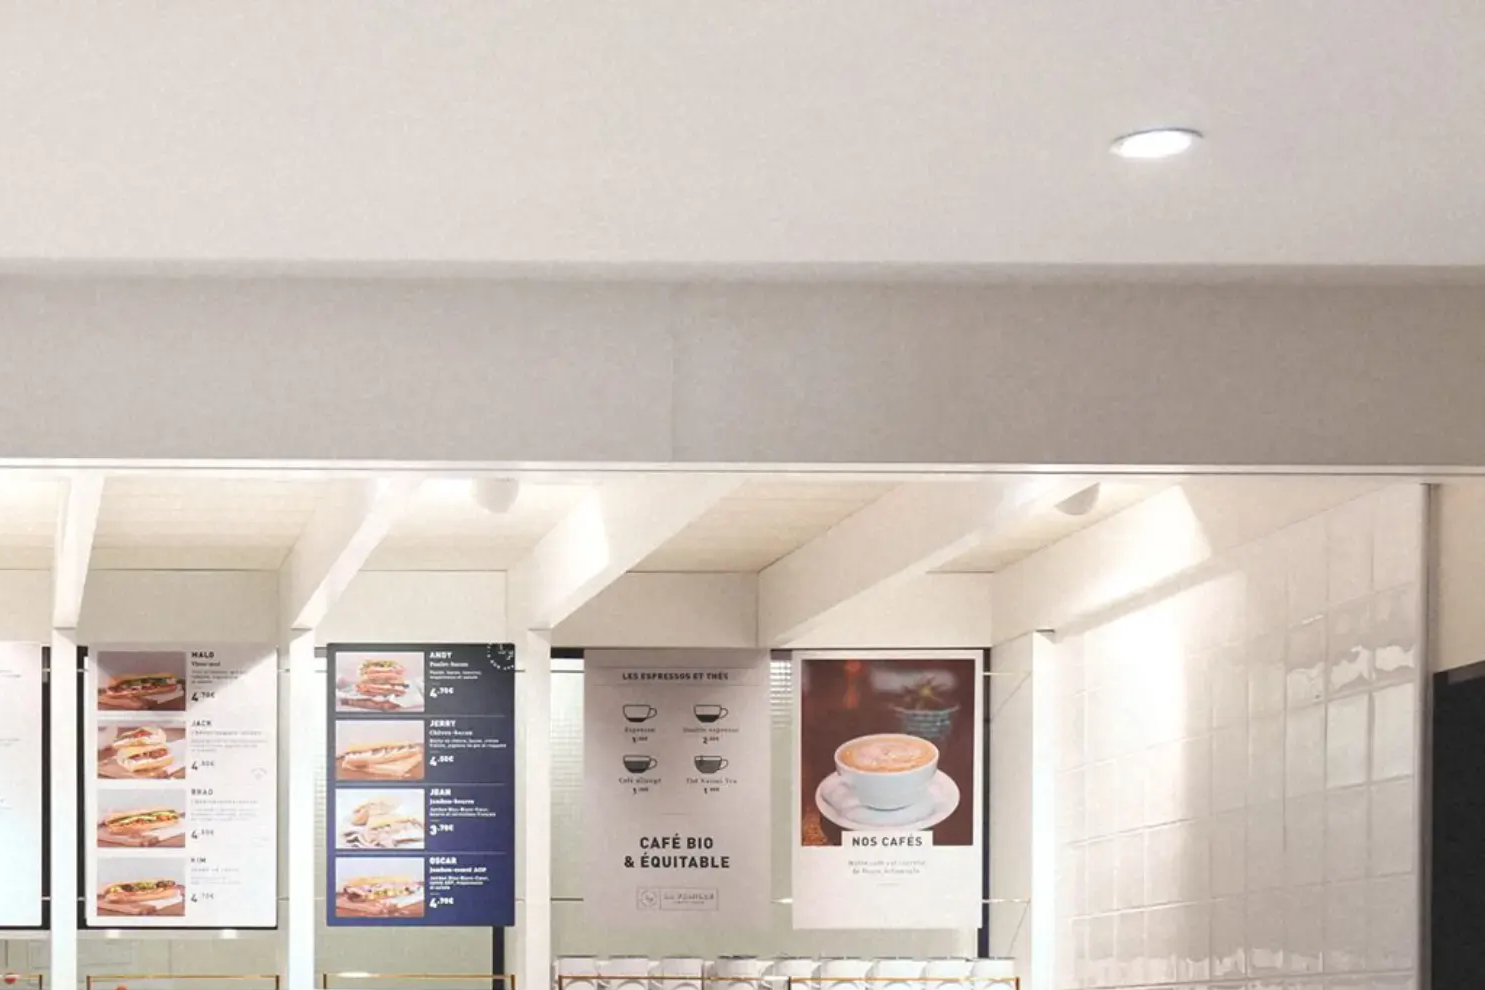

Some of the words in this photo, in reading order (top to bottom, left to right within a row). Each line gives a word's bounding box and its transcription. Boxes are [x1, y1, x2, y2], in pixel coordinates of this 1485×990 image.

[190, 650, 215, 659] MALO
[428, 651, 453, 659] ANDY
[622, 672, 639, 681] LES
[640, 672, 692, 681] ESPRESSOS
[693, 672, 704, 681] ET
[428, 719, 456, 728] JERRY
[428, 788, 452, 796] JEAN
[639, 832, 682, 850] CAFÉ
[686, 836, 714, 850] BIO
[851, 836, 878, 847] NOS
[881, 832, 923, 847] CAFÉS
[428, 856, 458, 865] OSCAR
[624, 855, 636, 869] &
[640, 851, 731, 869] ÉQUITABLE
